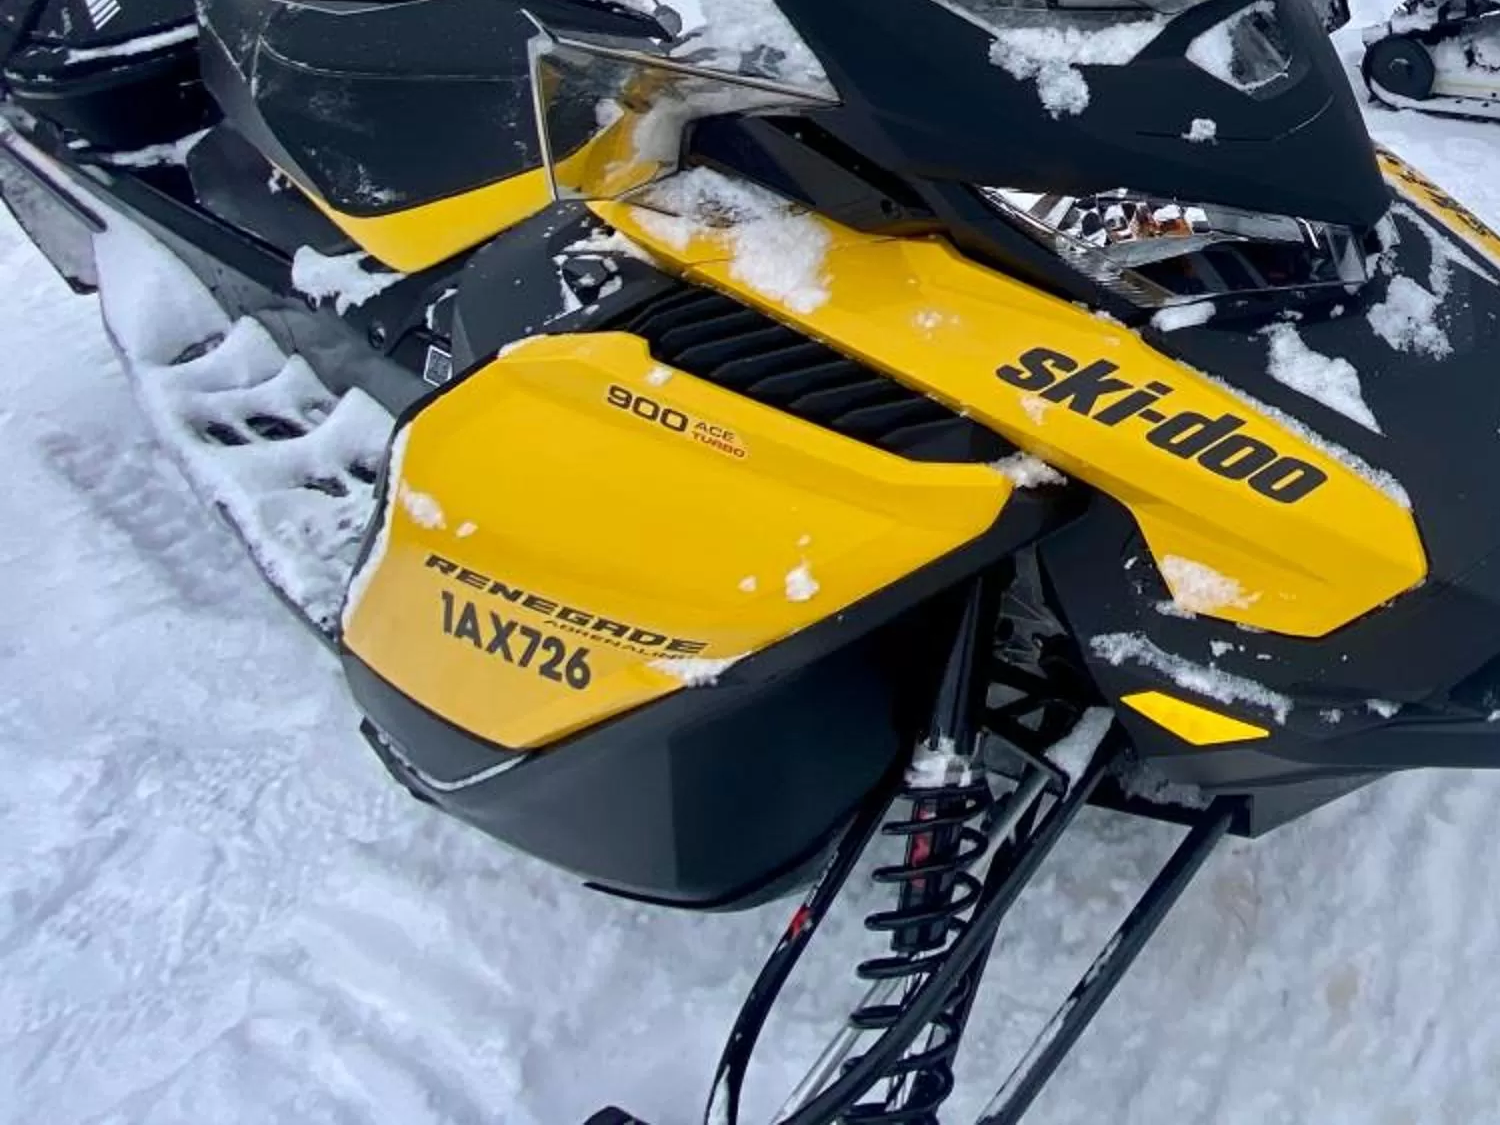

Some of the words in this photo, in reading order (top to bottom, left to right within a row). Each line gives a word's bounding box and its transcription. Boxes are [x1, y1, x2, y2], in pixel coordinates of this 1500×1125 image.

[607, 384, 689, 433] 900
[694, 421, 735, 443] ACE
[691, 430, 746, 458] TURBO
[424, 553, 709, 655] RENEGADE
[441, 590, 592, 691] 1AX726
